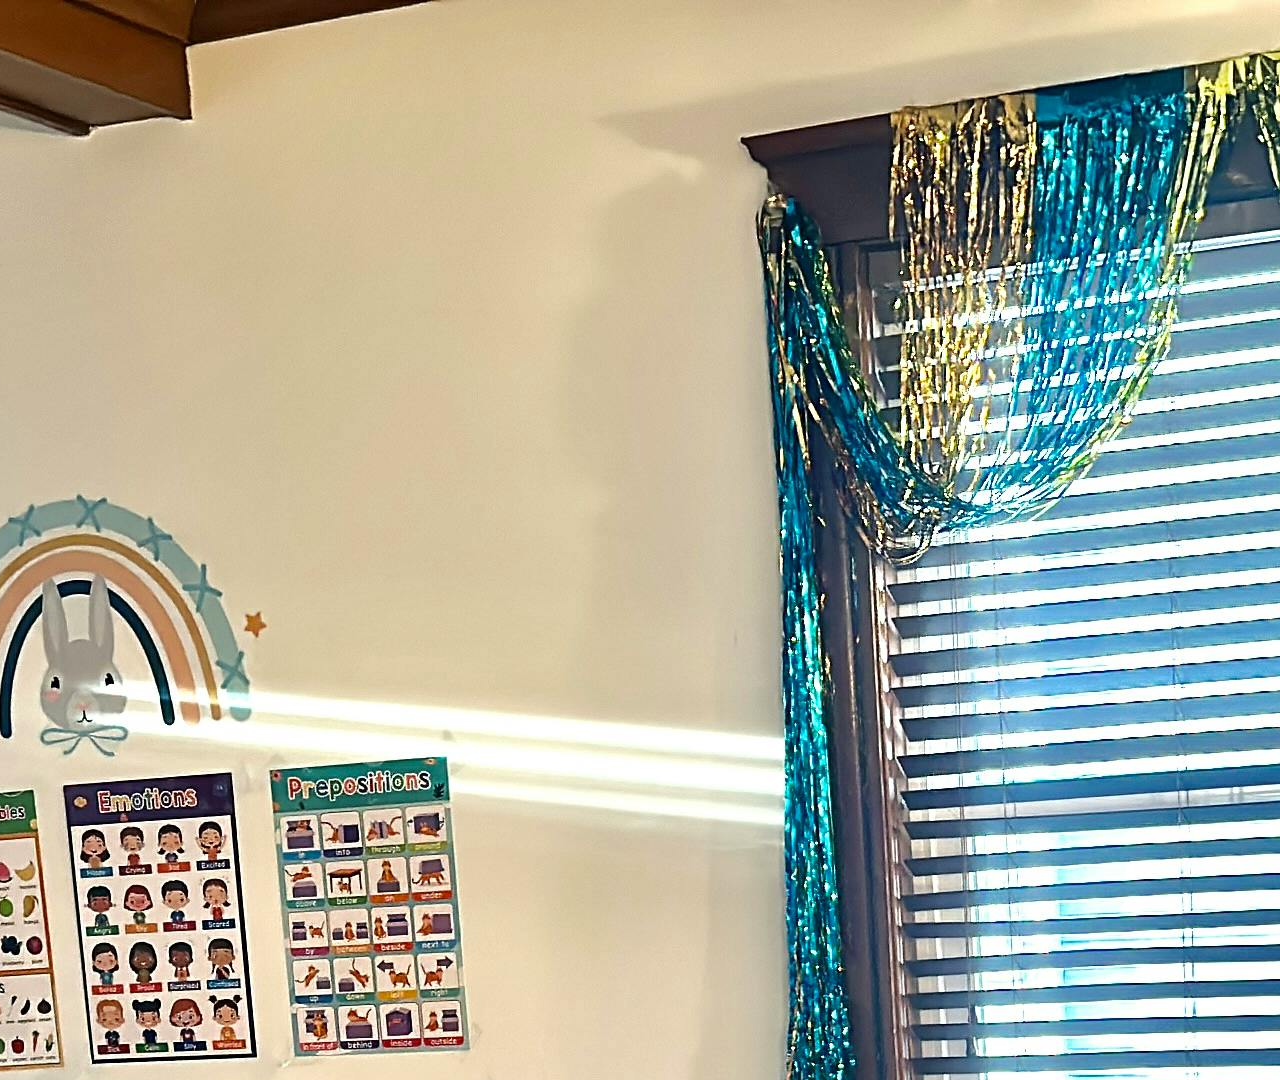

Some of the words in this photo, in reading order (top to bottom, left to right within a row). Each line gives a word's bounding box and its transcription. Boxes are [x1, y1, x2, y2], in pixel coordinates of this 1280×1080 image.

[287, 770, 431, 801] Prepositions
[97, 787, 198, 814] Emotions
[201, 861, 225, 869] Excited
[208, 920, 230, 928] Scared
[347, 1041, 372, 1049] behind
